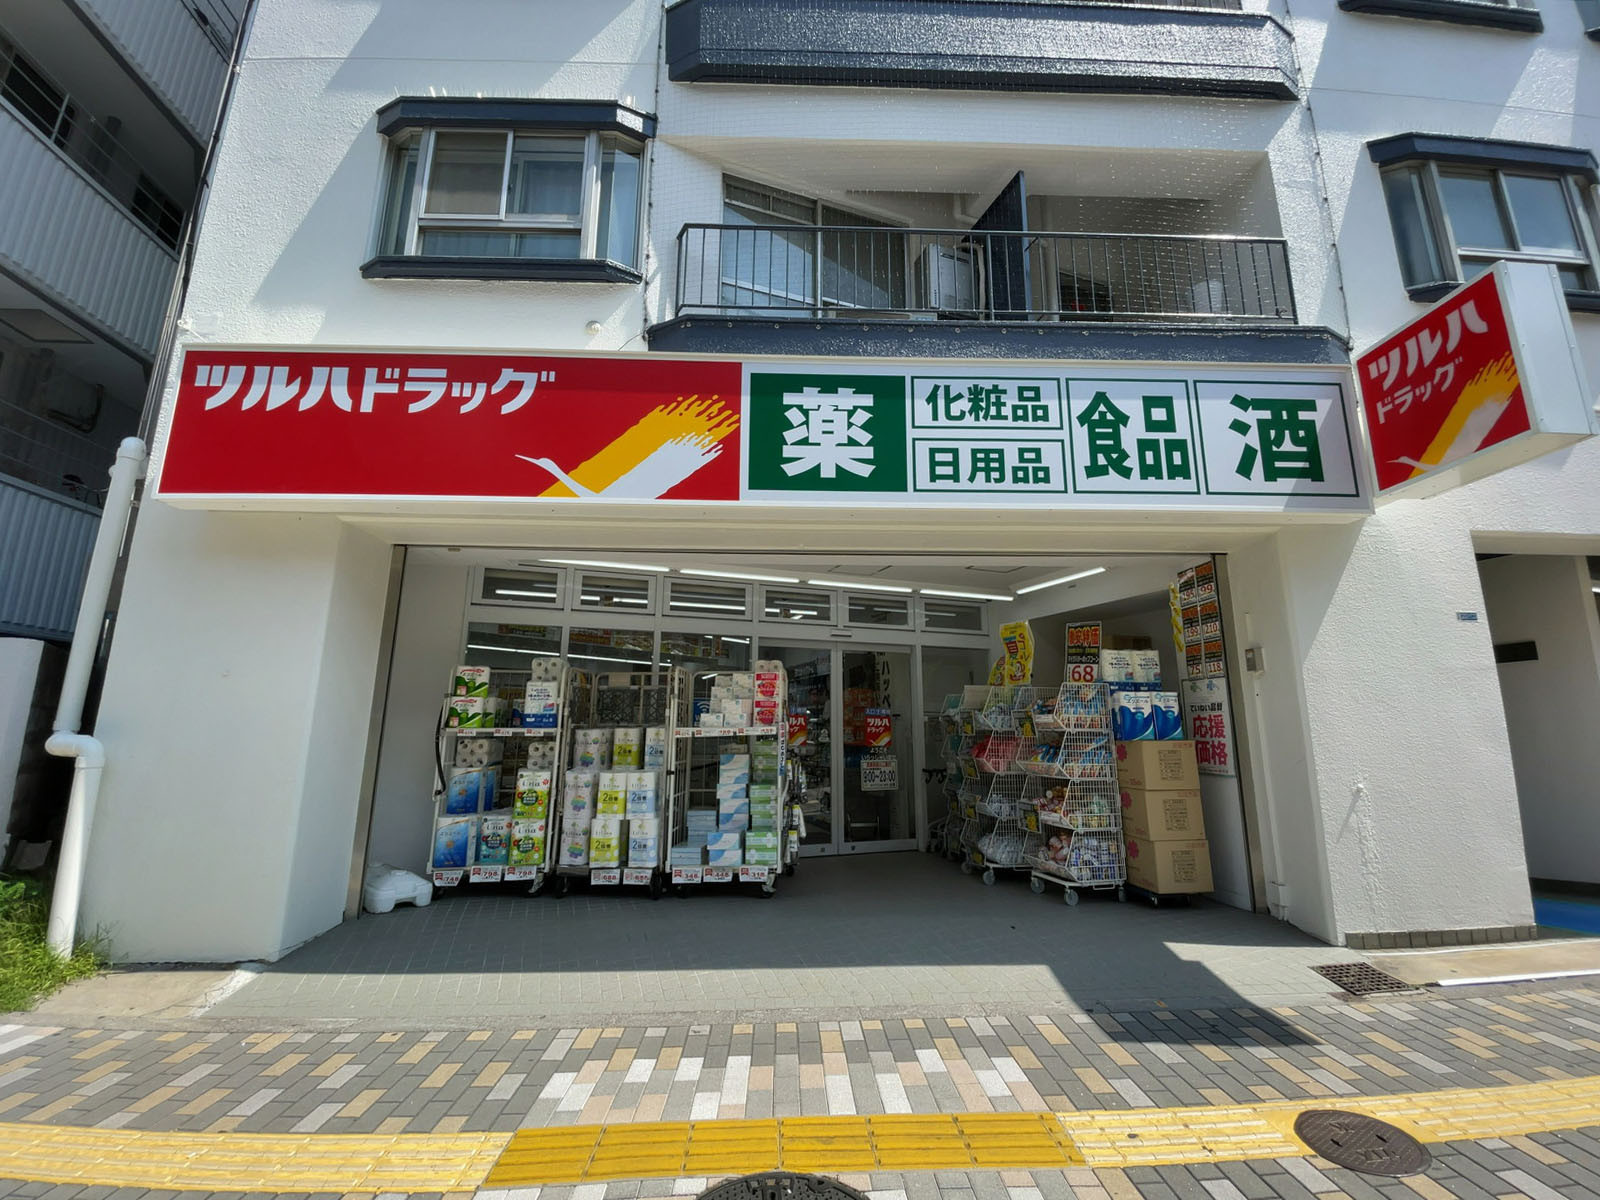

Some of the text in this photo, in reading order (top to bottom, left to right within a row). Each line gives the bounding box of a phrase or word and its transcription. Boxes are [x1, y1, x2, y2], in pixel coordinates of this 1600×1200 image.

[1368, 299, 1489, 391] ツルハ
[194, 364, 555, 415] ツルハドラッグ
[924, 384, 1050, 423] 化粧品
[1376, 356, 1464, 425] ドラッグ
[780, 387, 876, 478] 薬
[1076, 391, 1190, 482] 食品
[1229, 393, 1326, 483] 酒
[928, 447, 1051, 485] 日用品
[1071, 664, 1094, 683] 68
[866, 717, 890, 727] ツルハ
[1193, 713, 1226, 738] 応援
[1195, 740, 1228, 766] 価格
